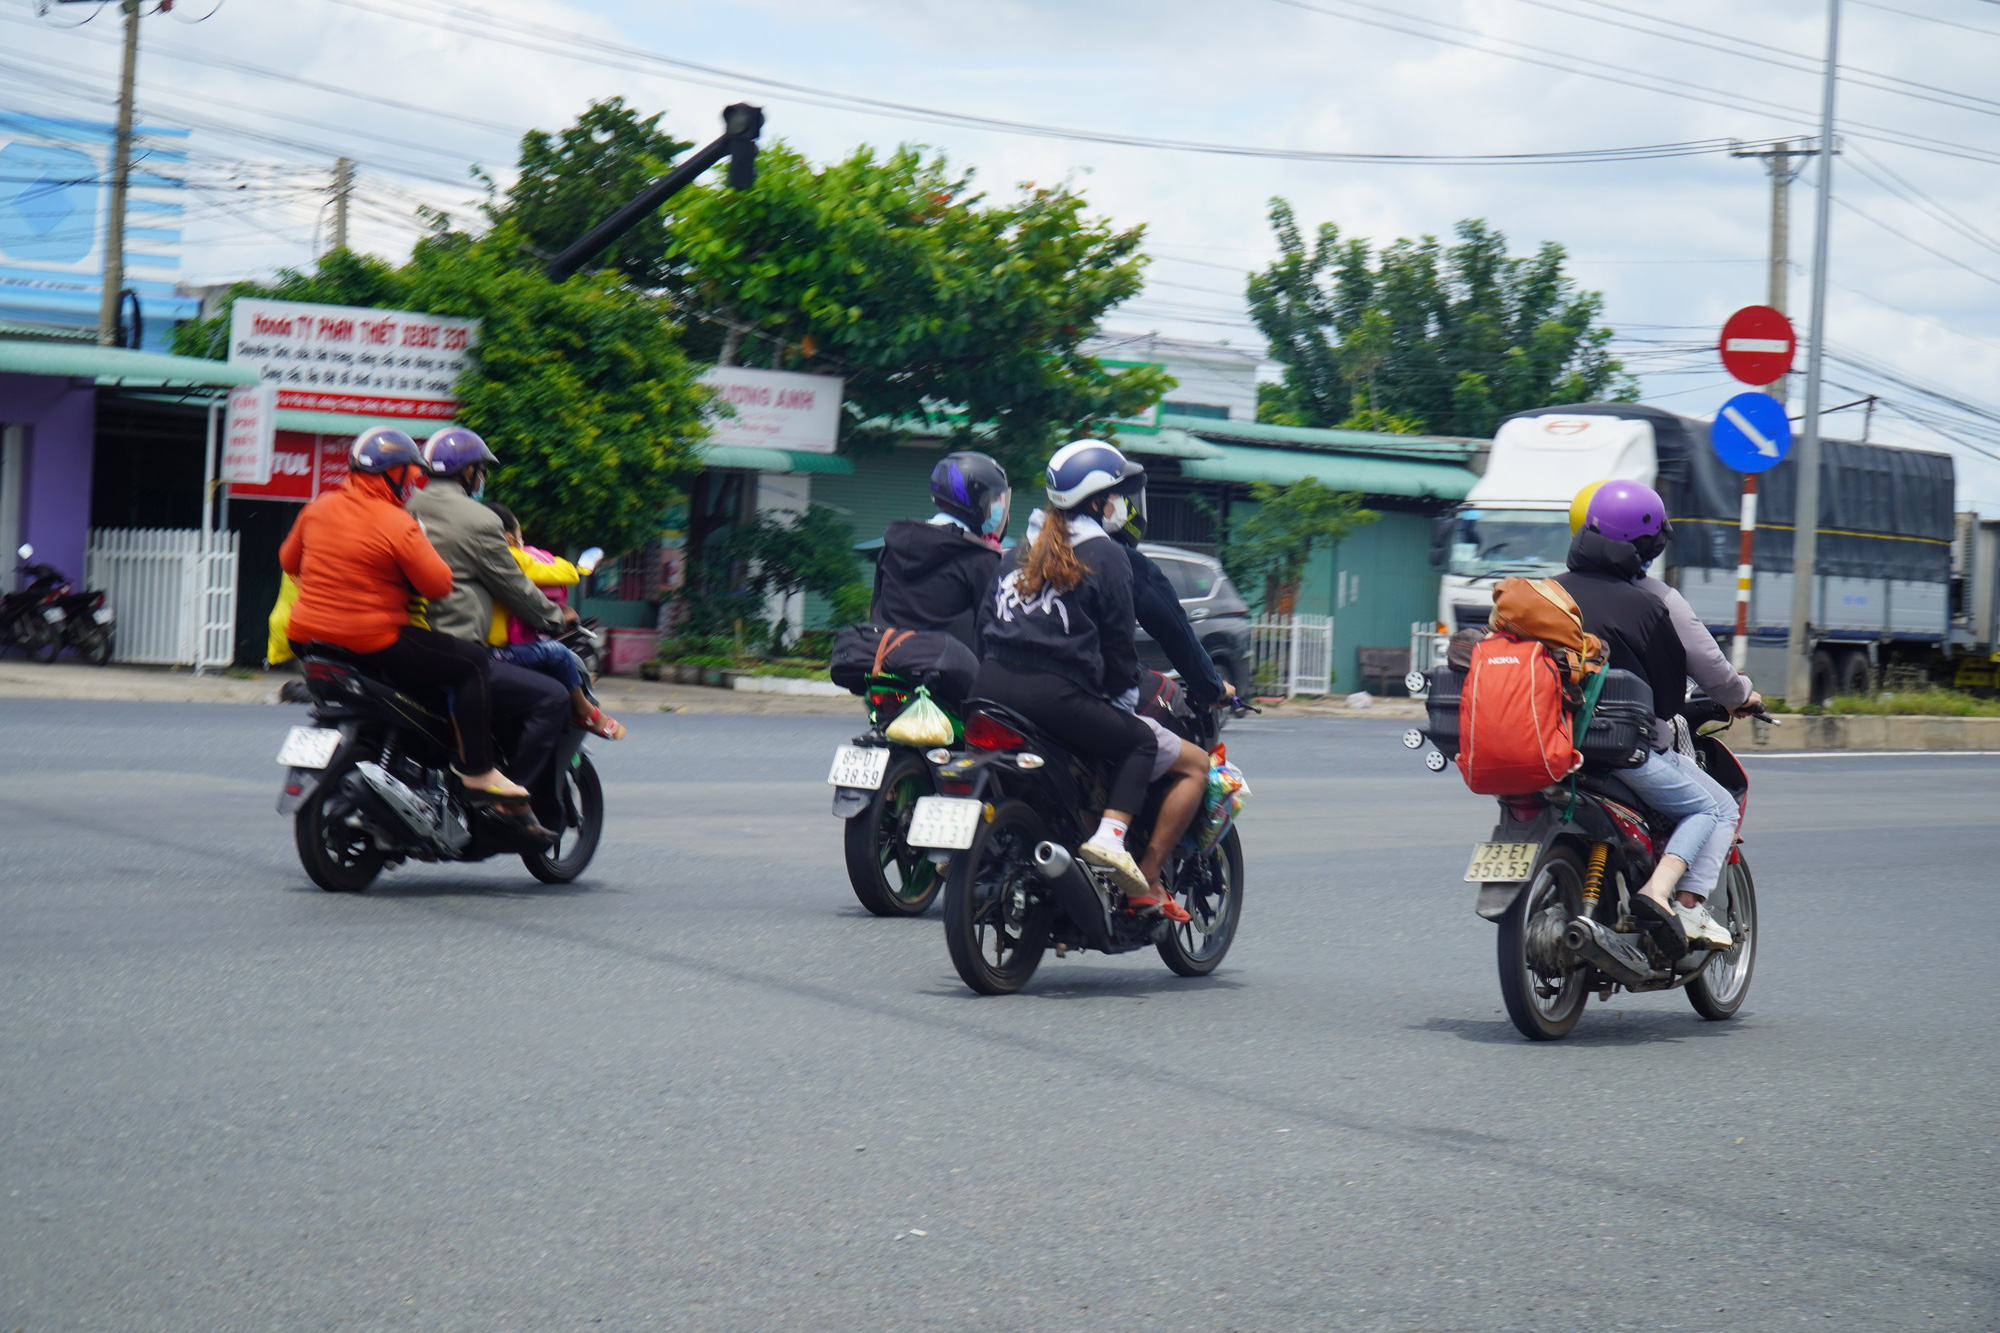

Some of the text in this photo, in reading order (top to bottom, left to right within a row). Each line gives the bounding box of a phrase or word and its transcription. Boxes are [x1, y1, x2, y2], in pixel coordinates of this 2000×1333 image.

[1488, 656, 1520, 665] NOKIA
[833, 767, 879, 786] 438.59
[1482, 844, 1528, 860] 73-E1
[1470, 862, 1529, 878] 356.53
